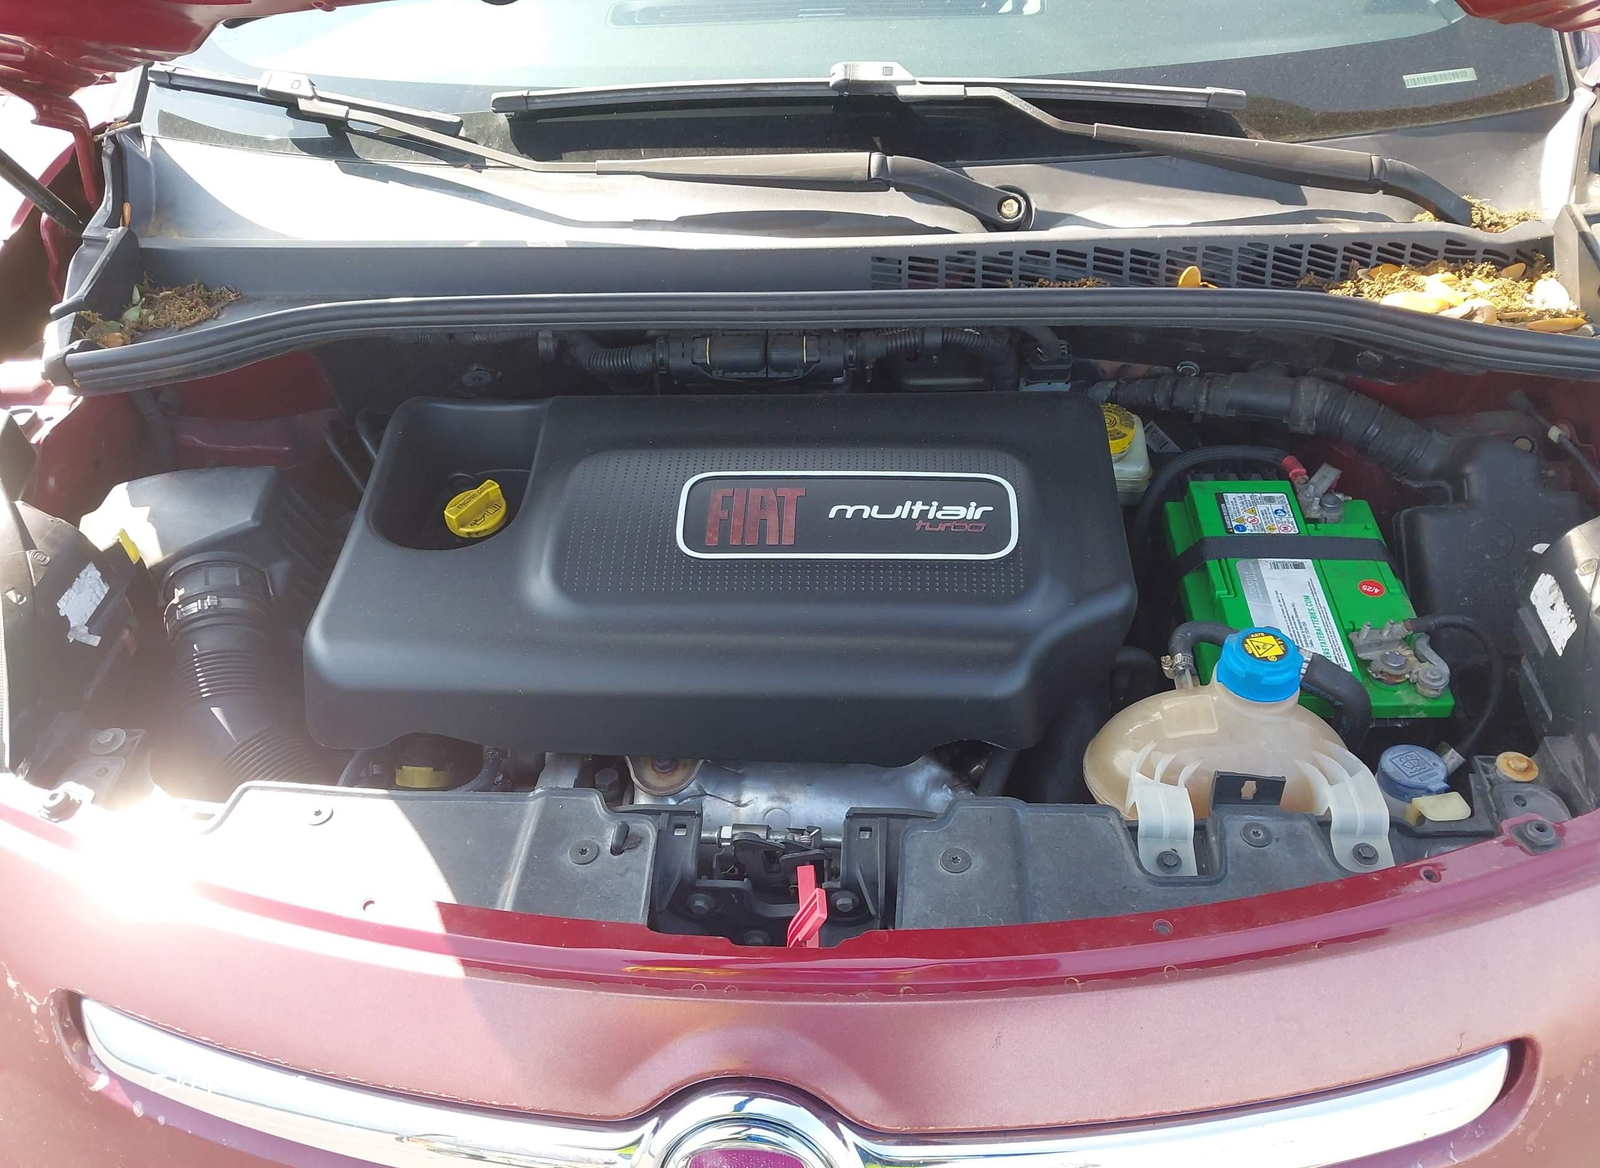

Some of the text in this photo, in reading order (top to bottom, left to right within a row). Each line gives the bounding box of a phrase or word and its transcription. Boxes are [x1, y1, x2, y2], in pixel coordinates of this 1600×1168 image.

[457, 492, 478, 510] ENGINE
[828, 500, 994, 520] multiair
[705, 487, 806, 546] FIAT
[915, 520, 988, 532] turbo
[1361, 584, 1381, 594] 4/25
